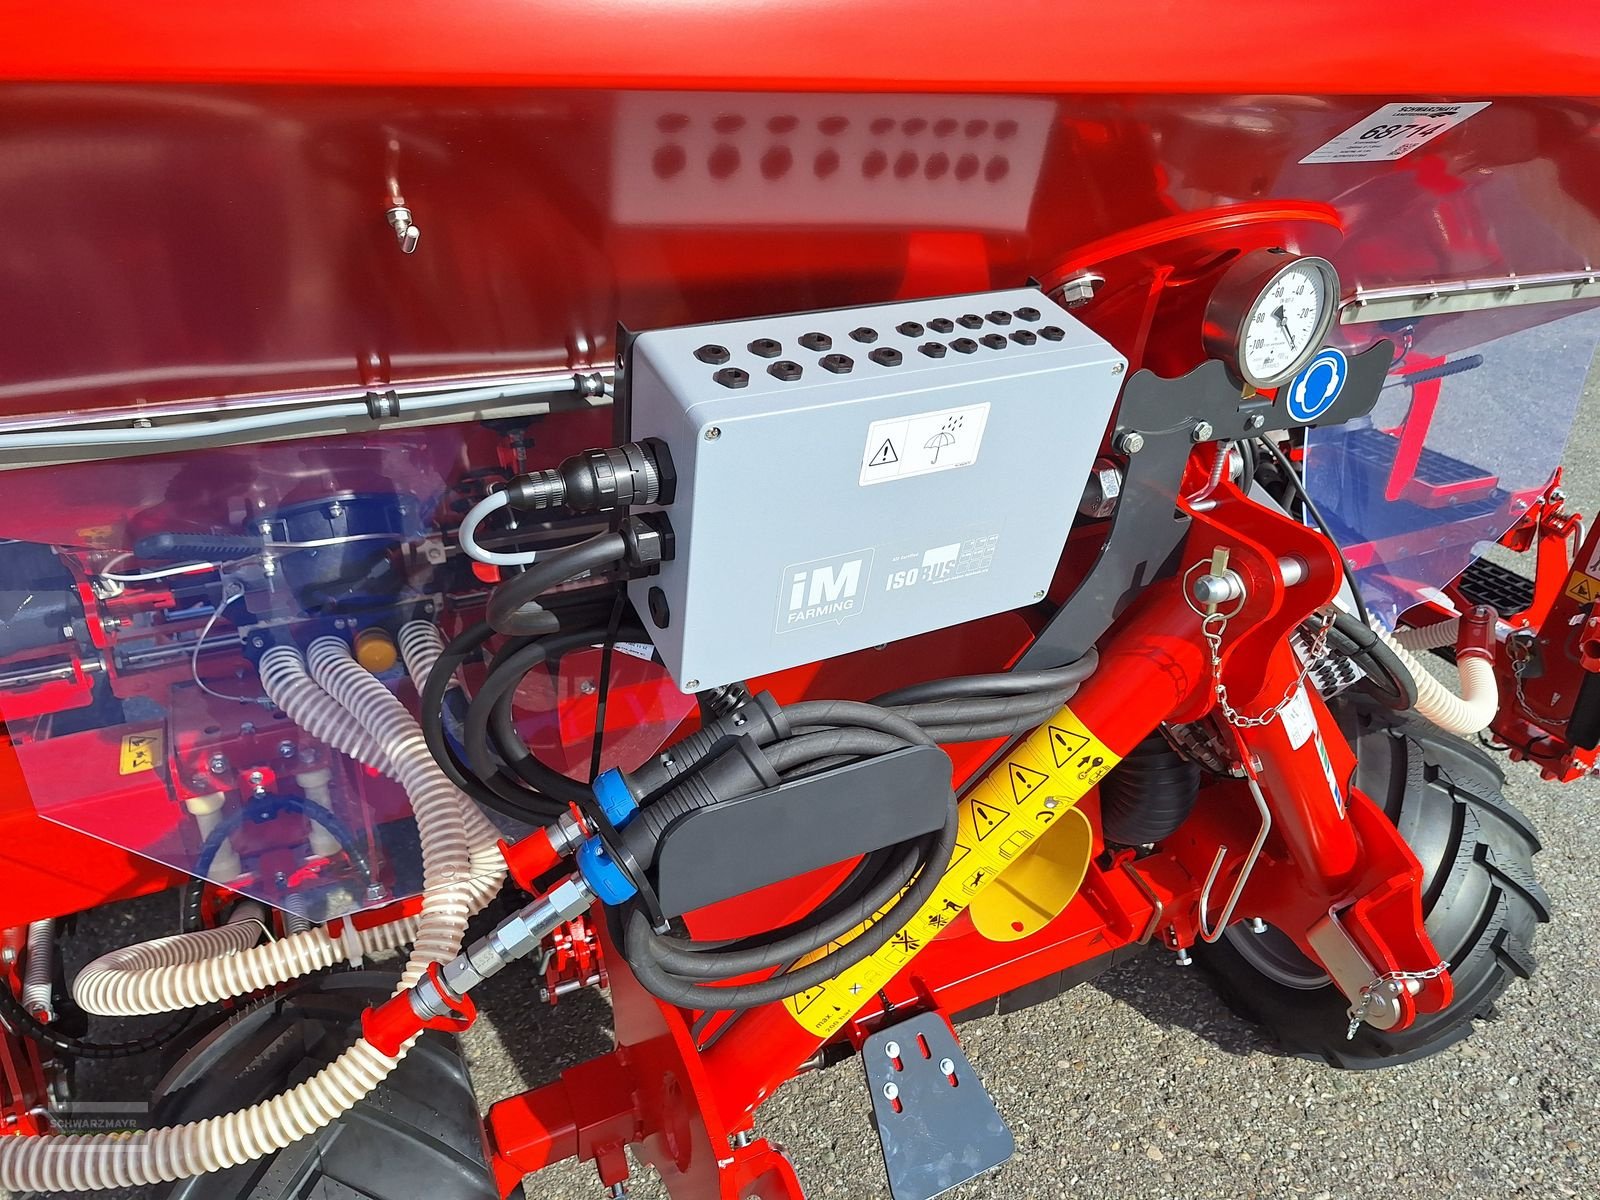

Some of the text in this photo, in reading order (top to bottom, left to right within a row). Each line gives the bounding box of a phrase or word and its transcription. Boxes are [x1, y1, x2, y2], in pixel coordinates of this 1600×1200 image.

[1360, 123, 1446, 140] 68714
[787, 599, 854, 624] FARMING
[815, 1012, 834, 1029] max.
